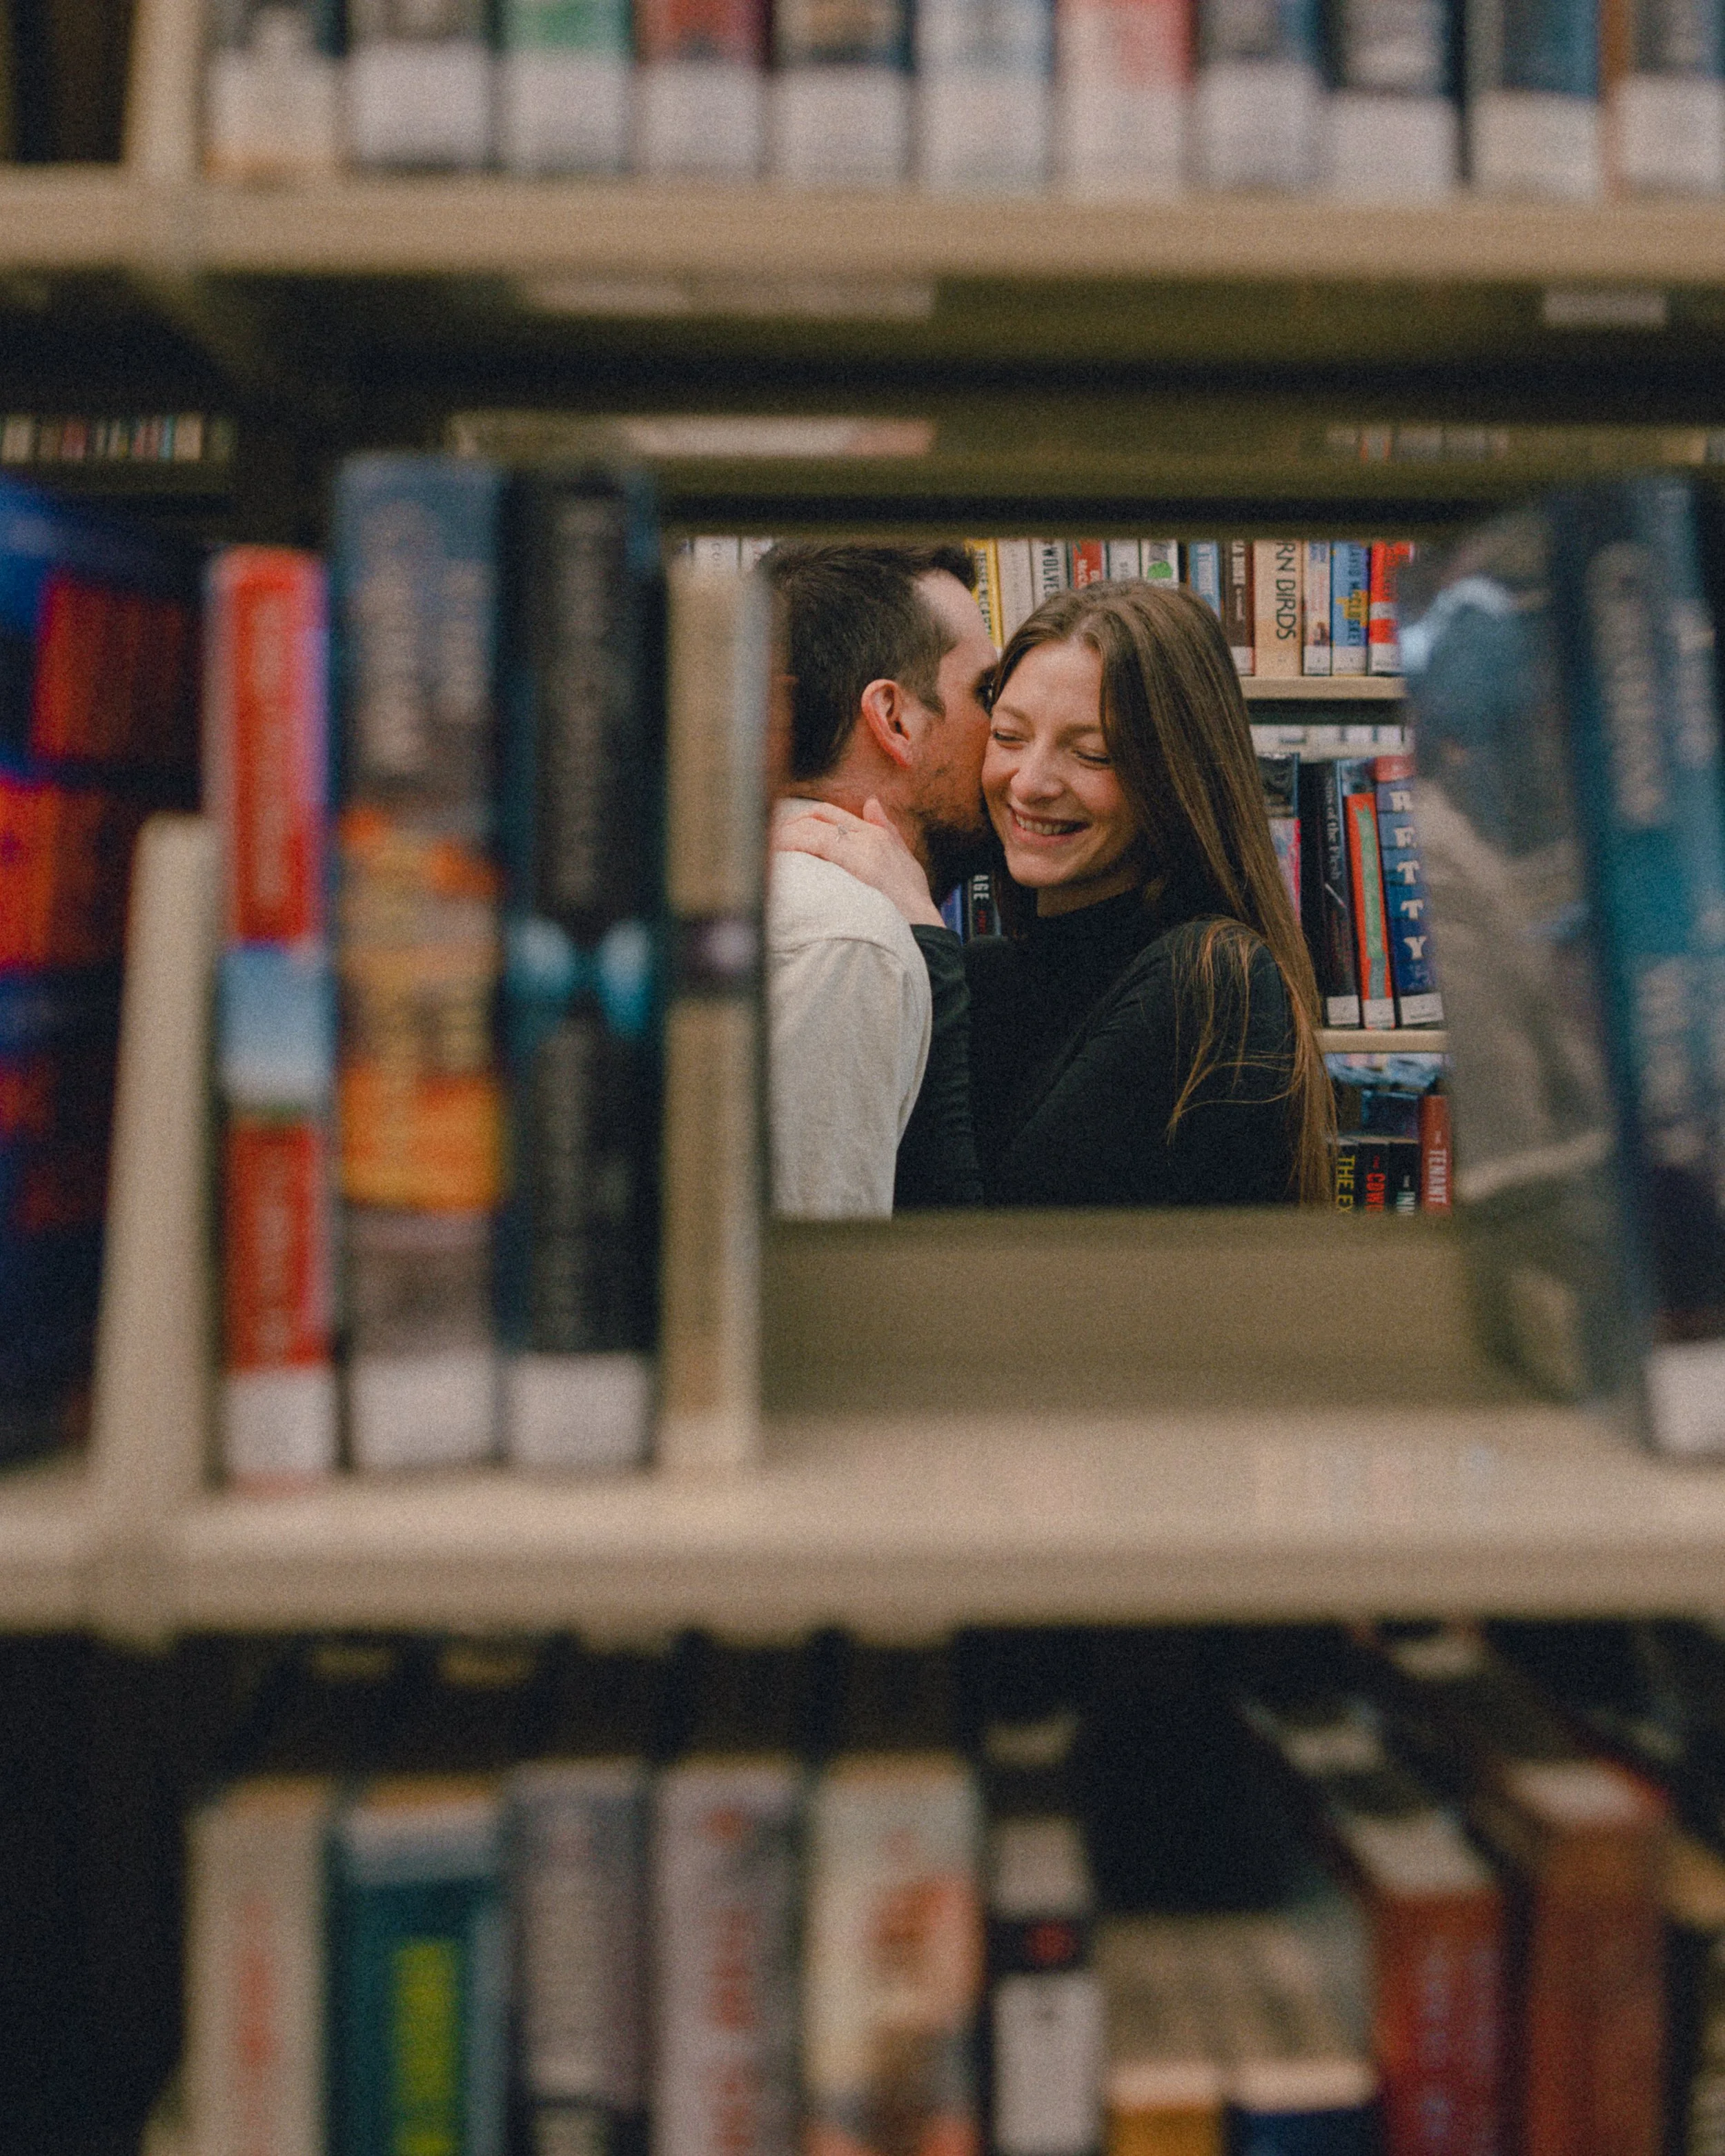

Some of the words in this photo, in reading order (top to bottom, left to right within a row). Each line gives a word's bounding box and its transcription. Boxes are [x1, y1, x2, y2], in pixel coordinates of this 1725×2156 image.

[1276, 579, 1296, 640] BIRDS
[1328, 822, 1339, 842] the
[1387, 762, 1428, 960] RETTY
[1336, 1155, 1355, 1190] THE
[1428, 1149, 1447, 1204] TENANT
